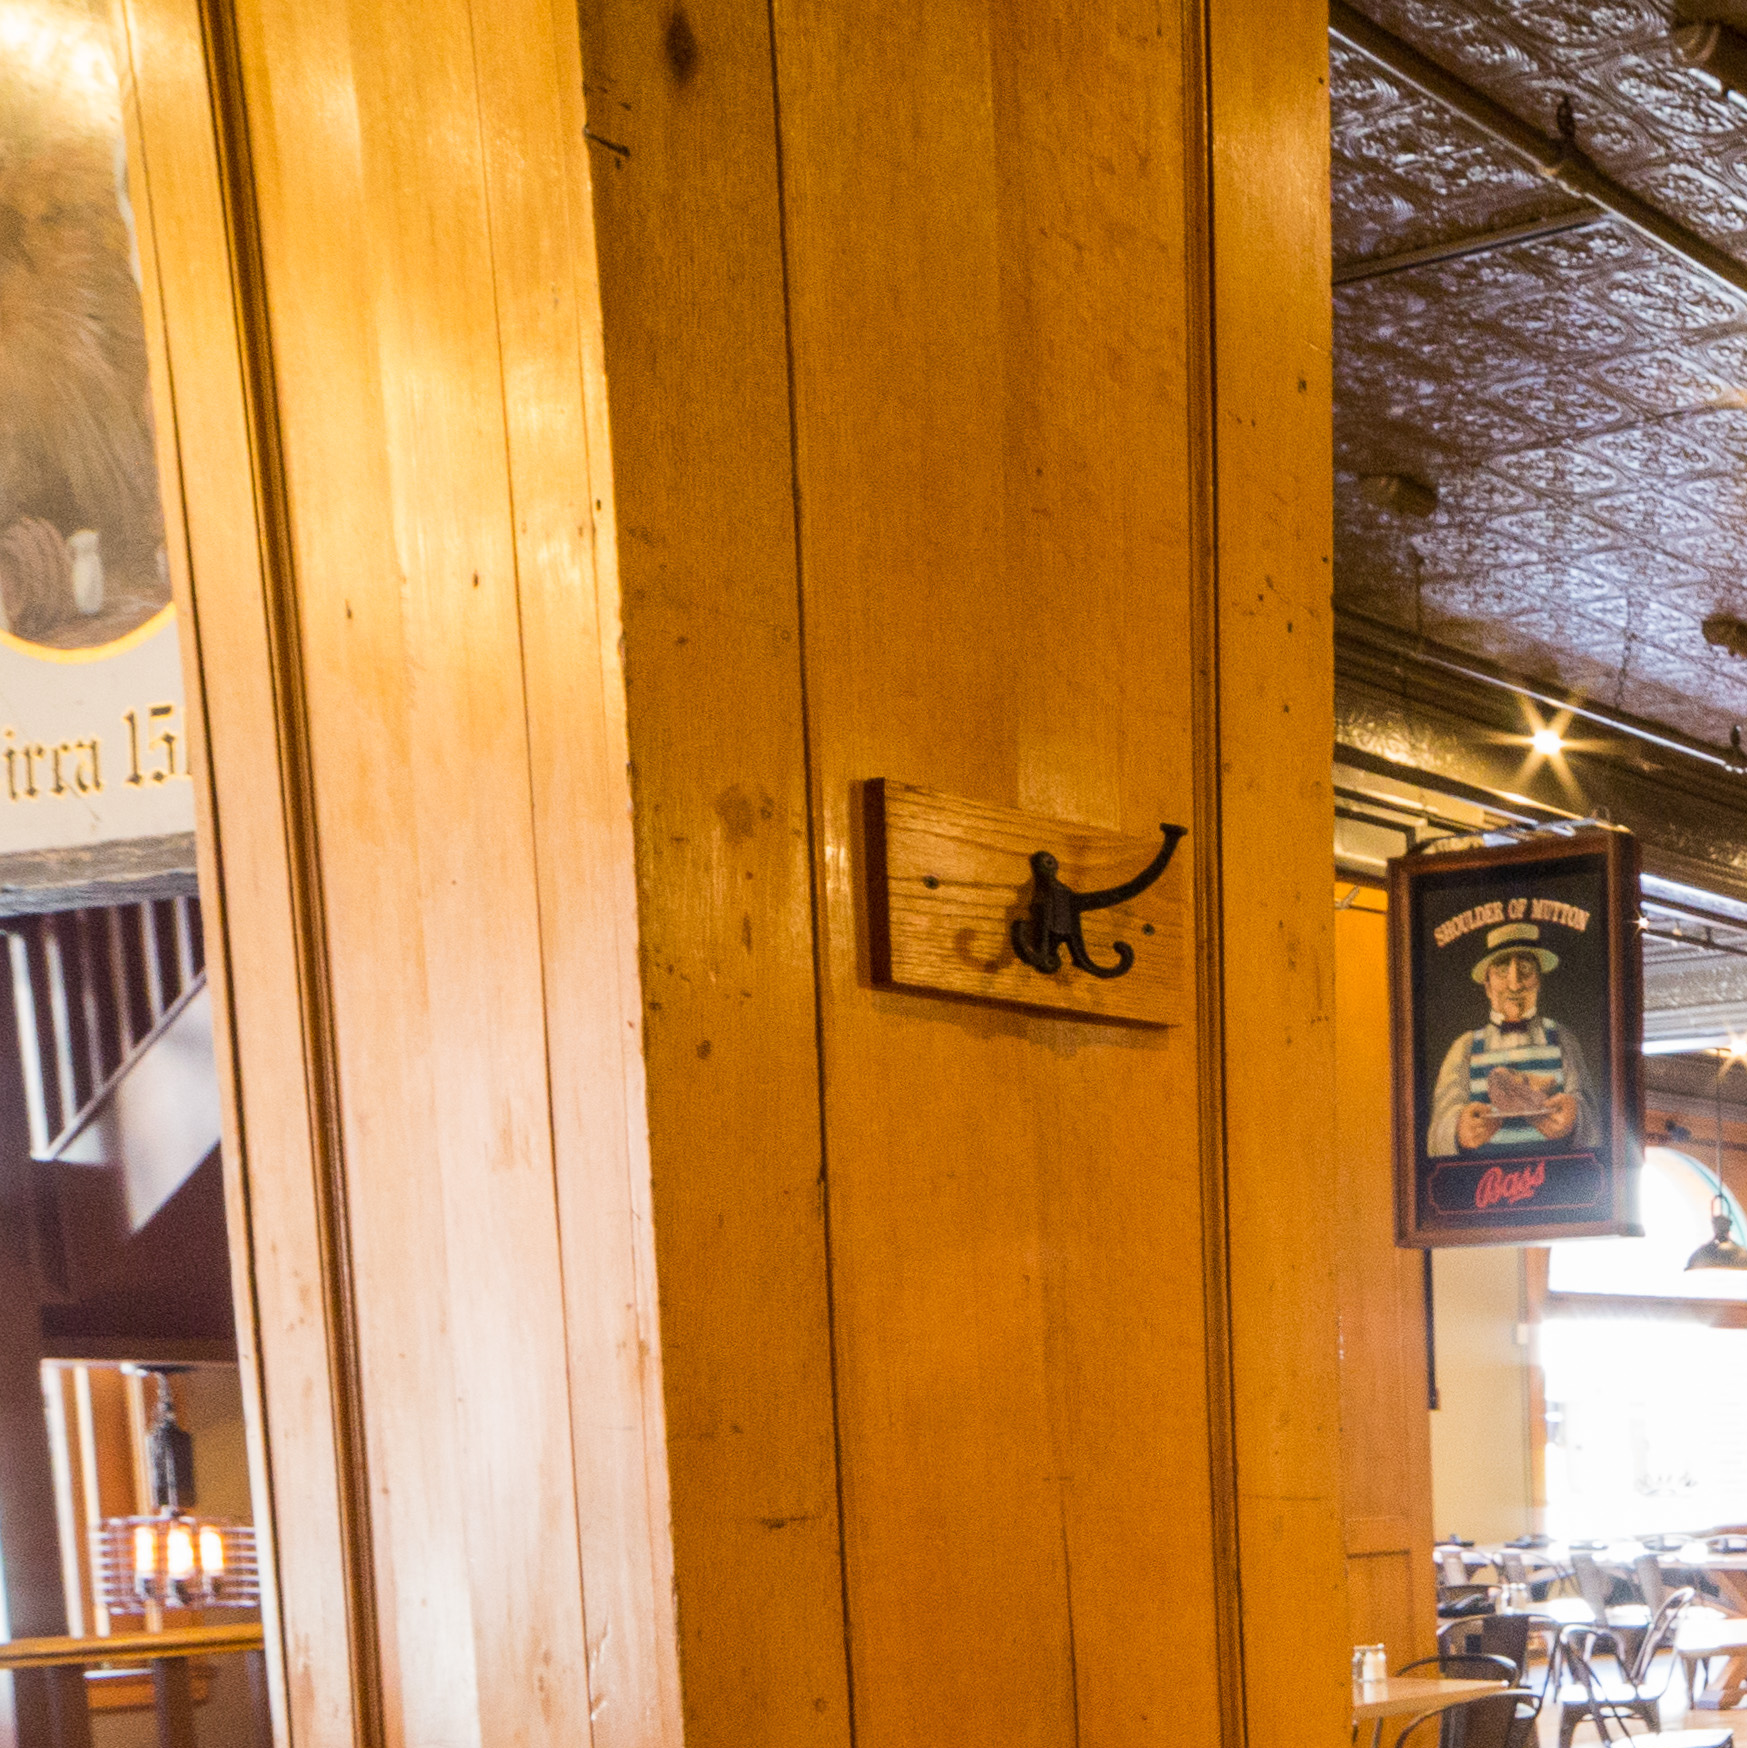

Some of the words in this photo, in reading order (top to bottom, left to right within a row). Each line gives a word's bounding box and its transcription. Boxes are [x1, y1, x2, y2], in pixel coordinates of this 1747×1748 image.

[2, 726, 103, 802] irca
[122, 704, 192, 789] 15
[1433, 901, 1506, 949] SHOULDER
[1507, 898, 1528, 920] OF
[1530, 898, 1591, 933] MUTTON
[1475, 1160, 1546, 1209] Bass
